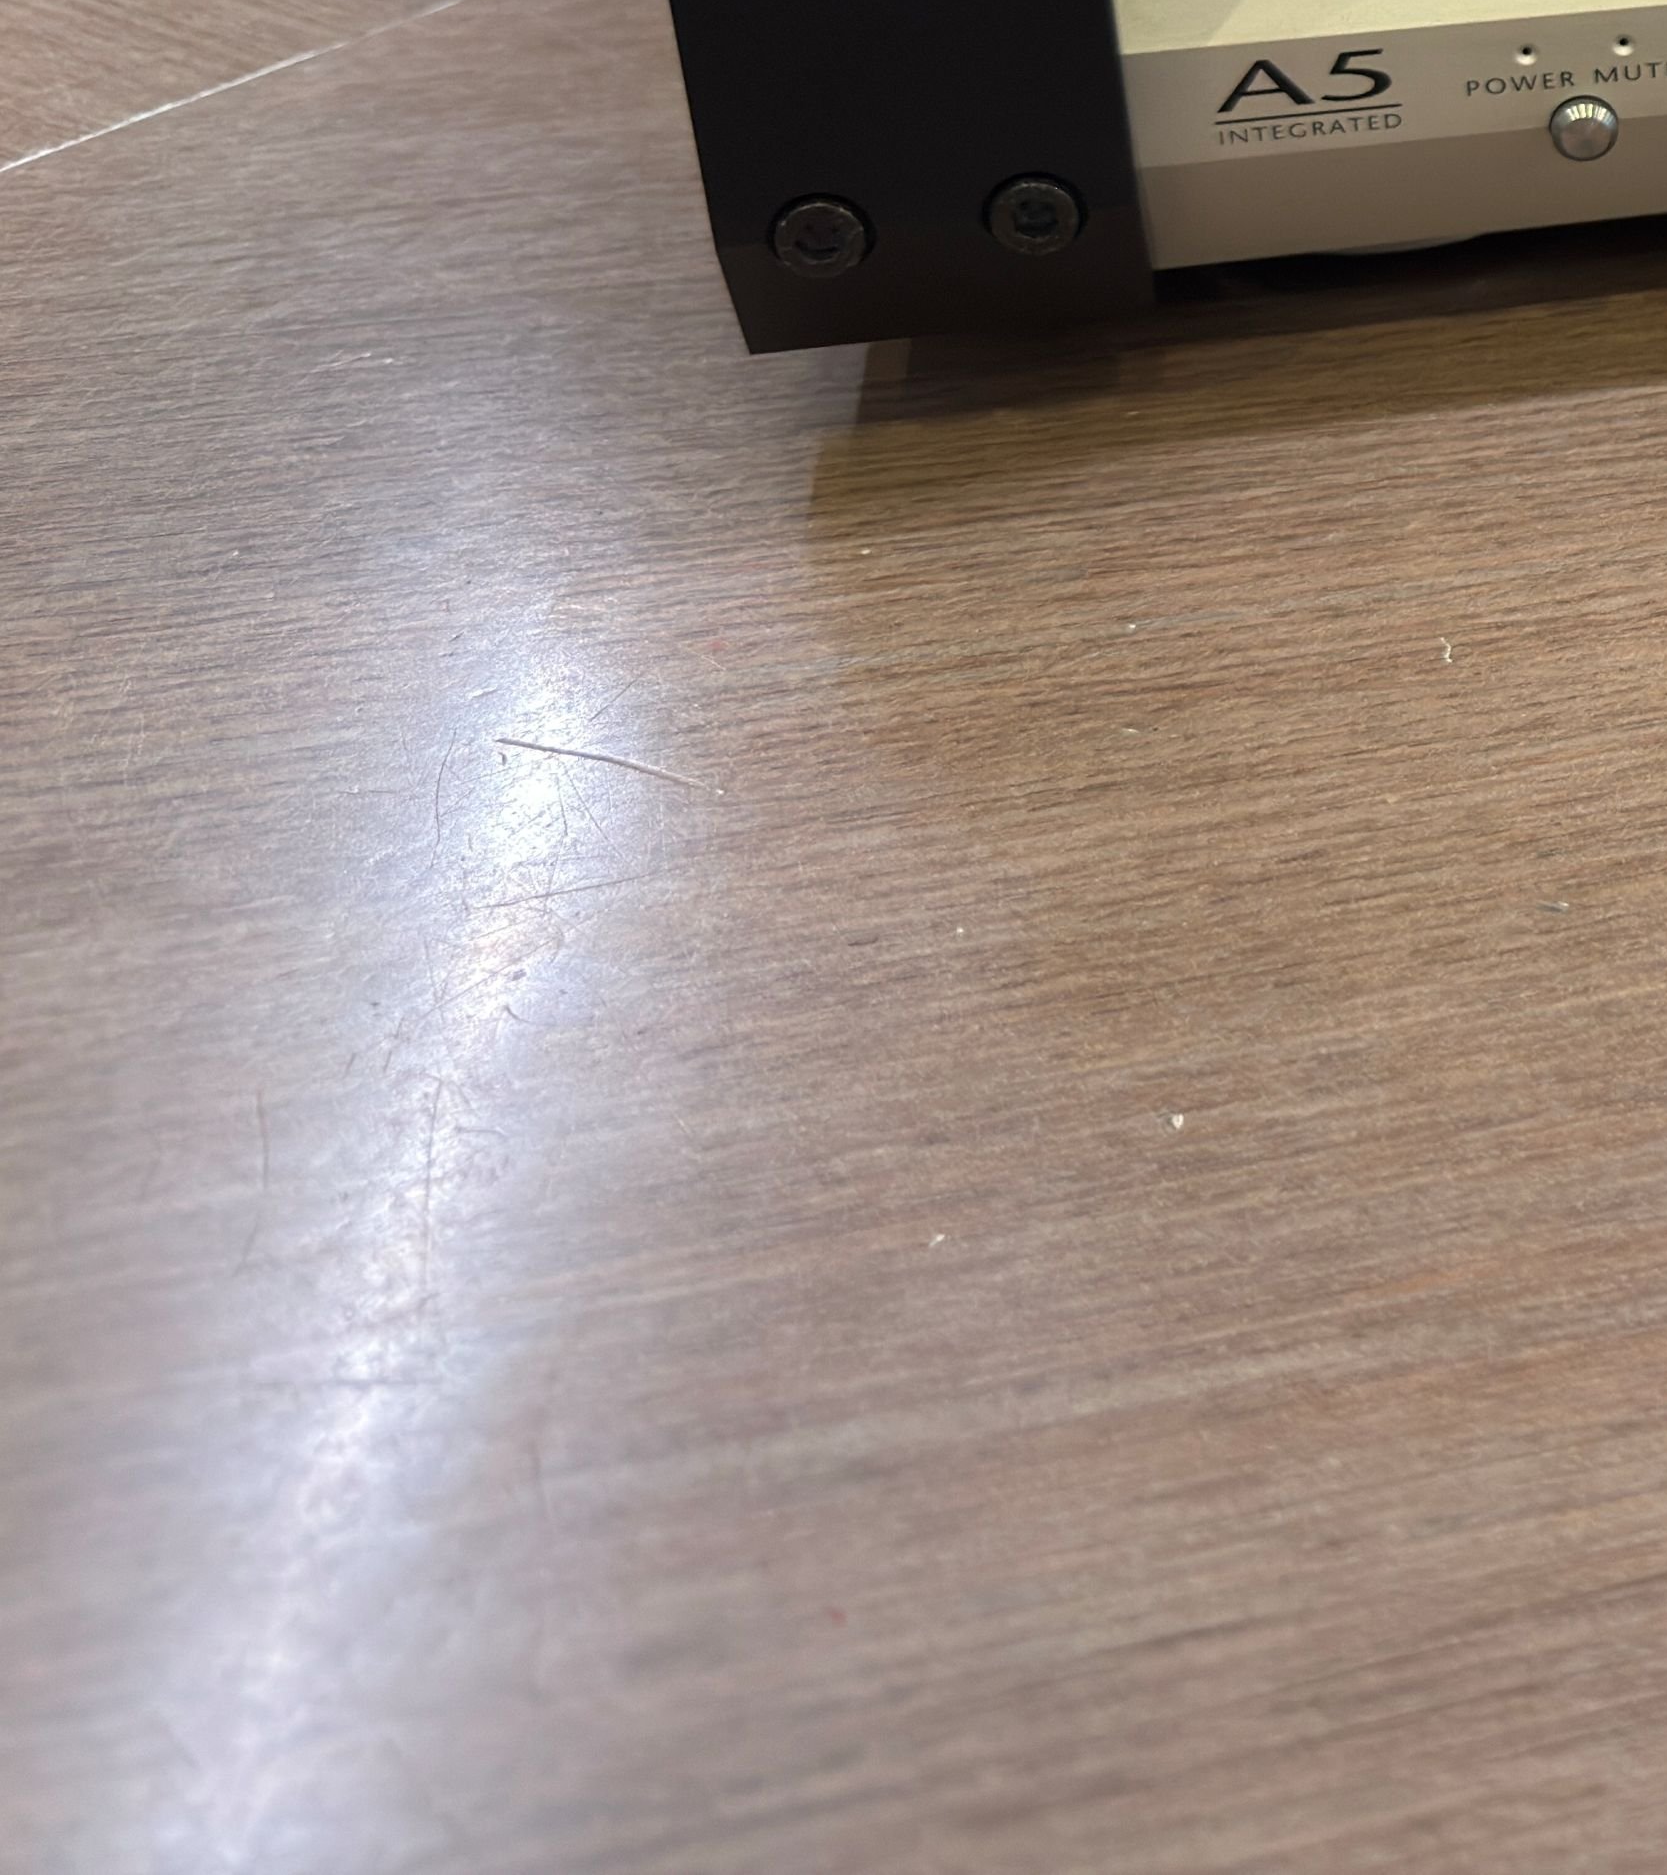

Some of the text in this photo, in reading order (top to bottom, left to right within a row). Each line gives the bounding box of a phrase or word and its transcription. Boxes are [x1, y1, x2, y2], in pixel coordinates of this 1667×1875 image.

[1217, 48, 1393, 112] A5
[1466, 71, 1576, 97] POWER
[1218, 113, 1403, 146] INTEGRATED
